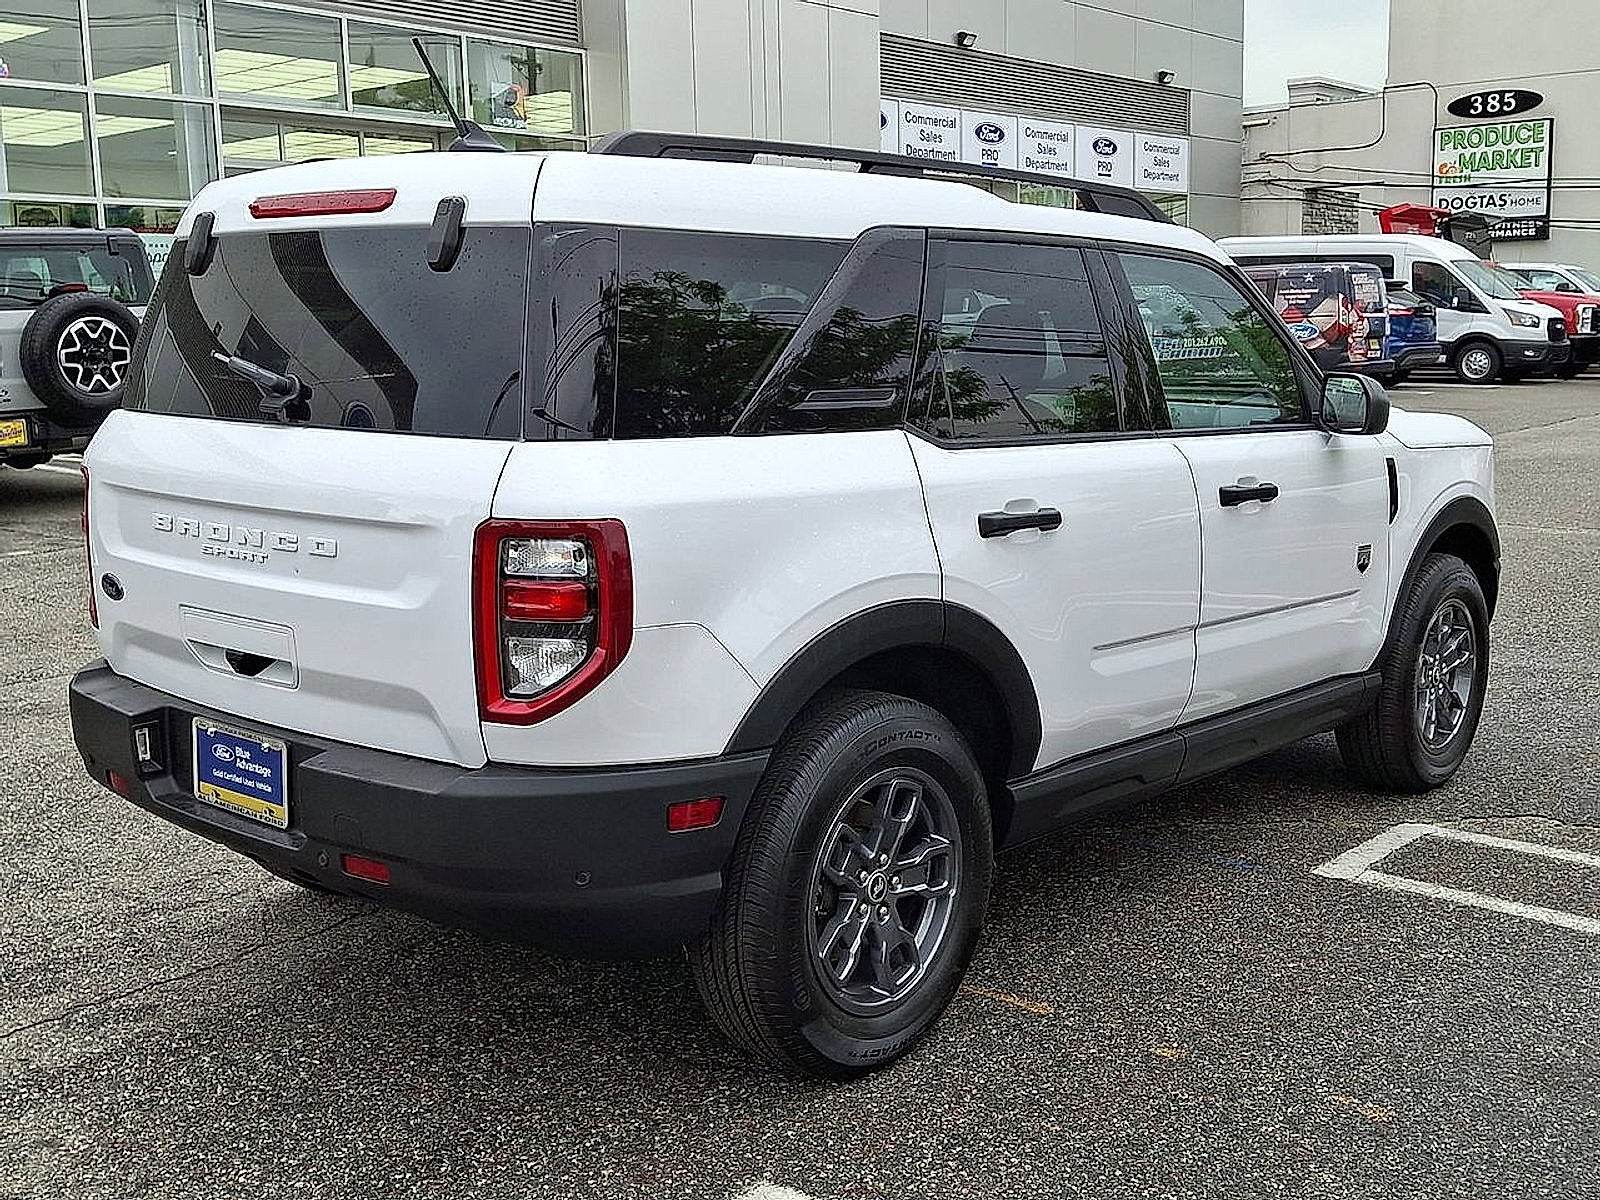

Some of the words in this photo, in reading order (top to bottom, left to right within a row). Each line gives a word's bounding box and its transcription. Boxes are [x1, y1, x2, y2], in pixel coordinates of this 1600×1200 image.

[1469, 91, 1517, 115] 385
[904, 110, 957, 129] Commercial
[918, 128, 943, 144] Sales
[1024, 126, 1069, 143] Commercial
[1439, 122, 1546, 151] PRODUCE
[905, 143, 957, 161] Department
[981, 148, 999, 161] PRO
[1036, 142, 1058, 156] Sales
[1143, 141, 1181, 156] Commercial
[1025, 156, 1068, 172] Department
[1097, 160, 1113, 173] PRO
[1153, 156, 1170, 168] Sales
[1458, 146, 1545, 174] MARKET
[1143, 168, 1180, 182] Department
[1510, 196, 1541, 207] HOME
[152, 511, 339, 559] BRONCO
[200, 542, 269, 564] SPORT
[235, 745, 251, 760] Blue
[236, 757, 272, 778] Advantage
